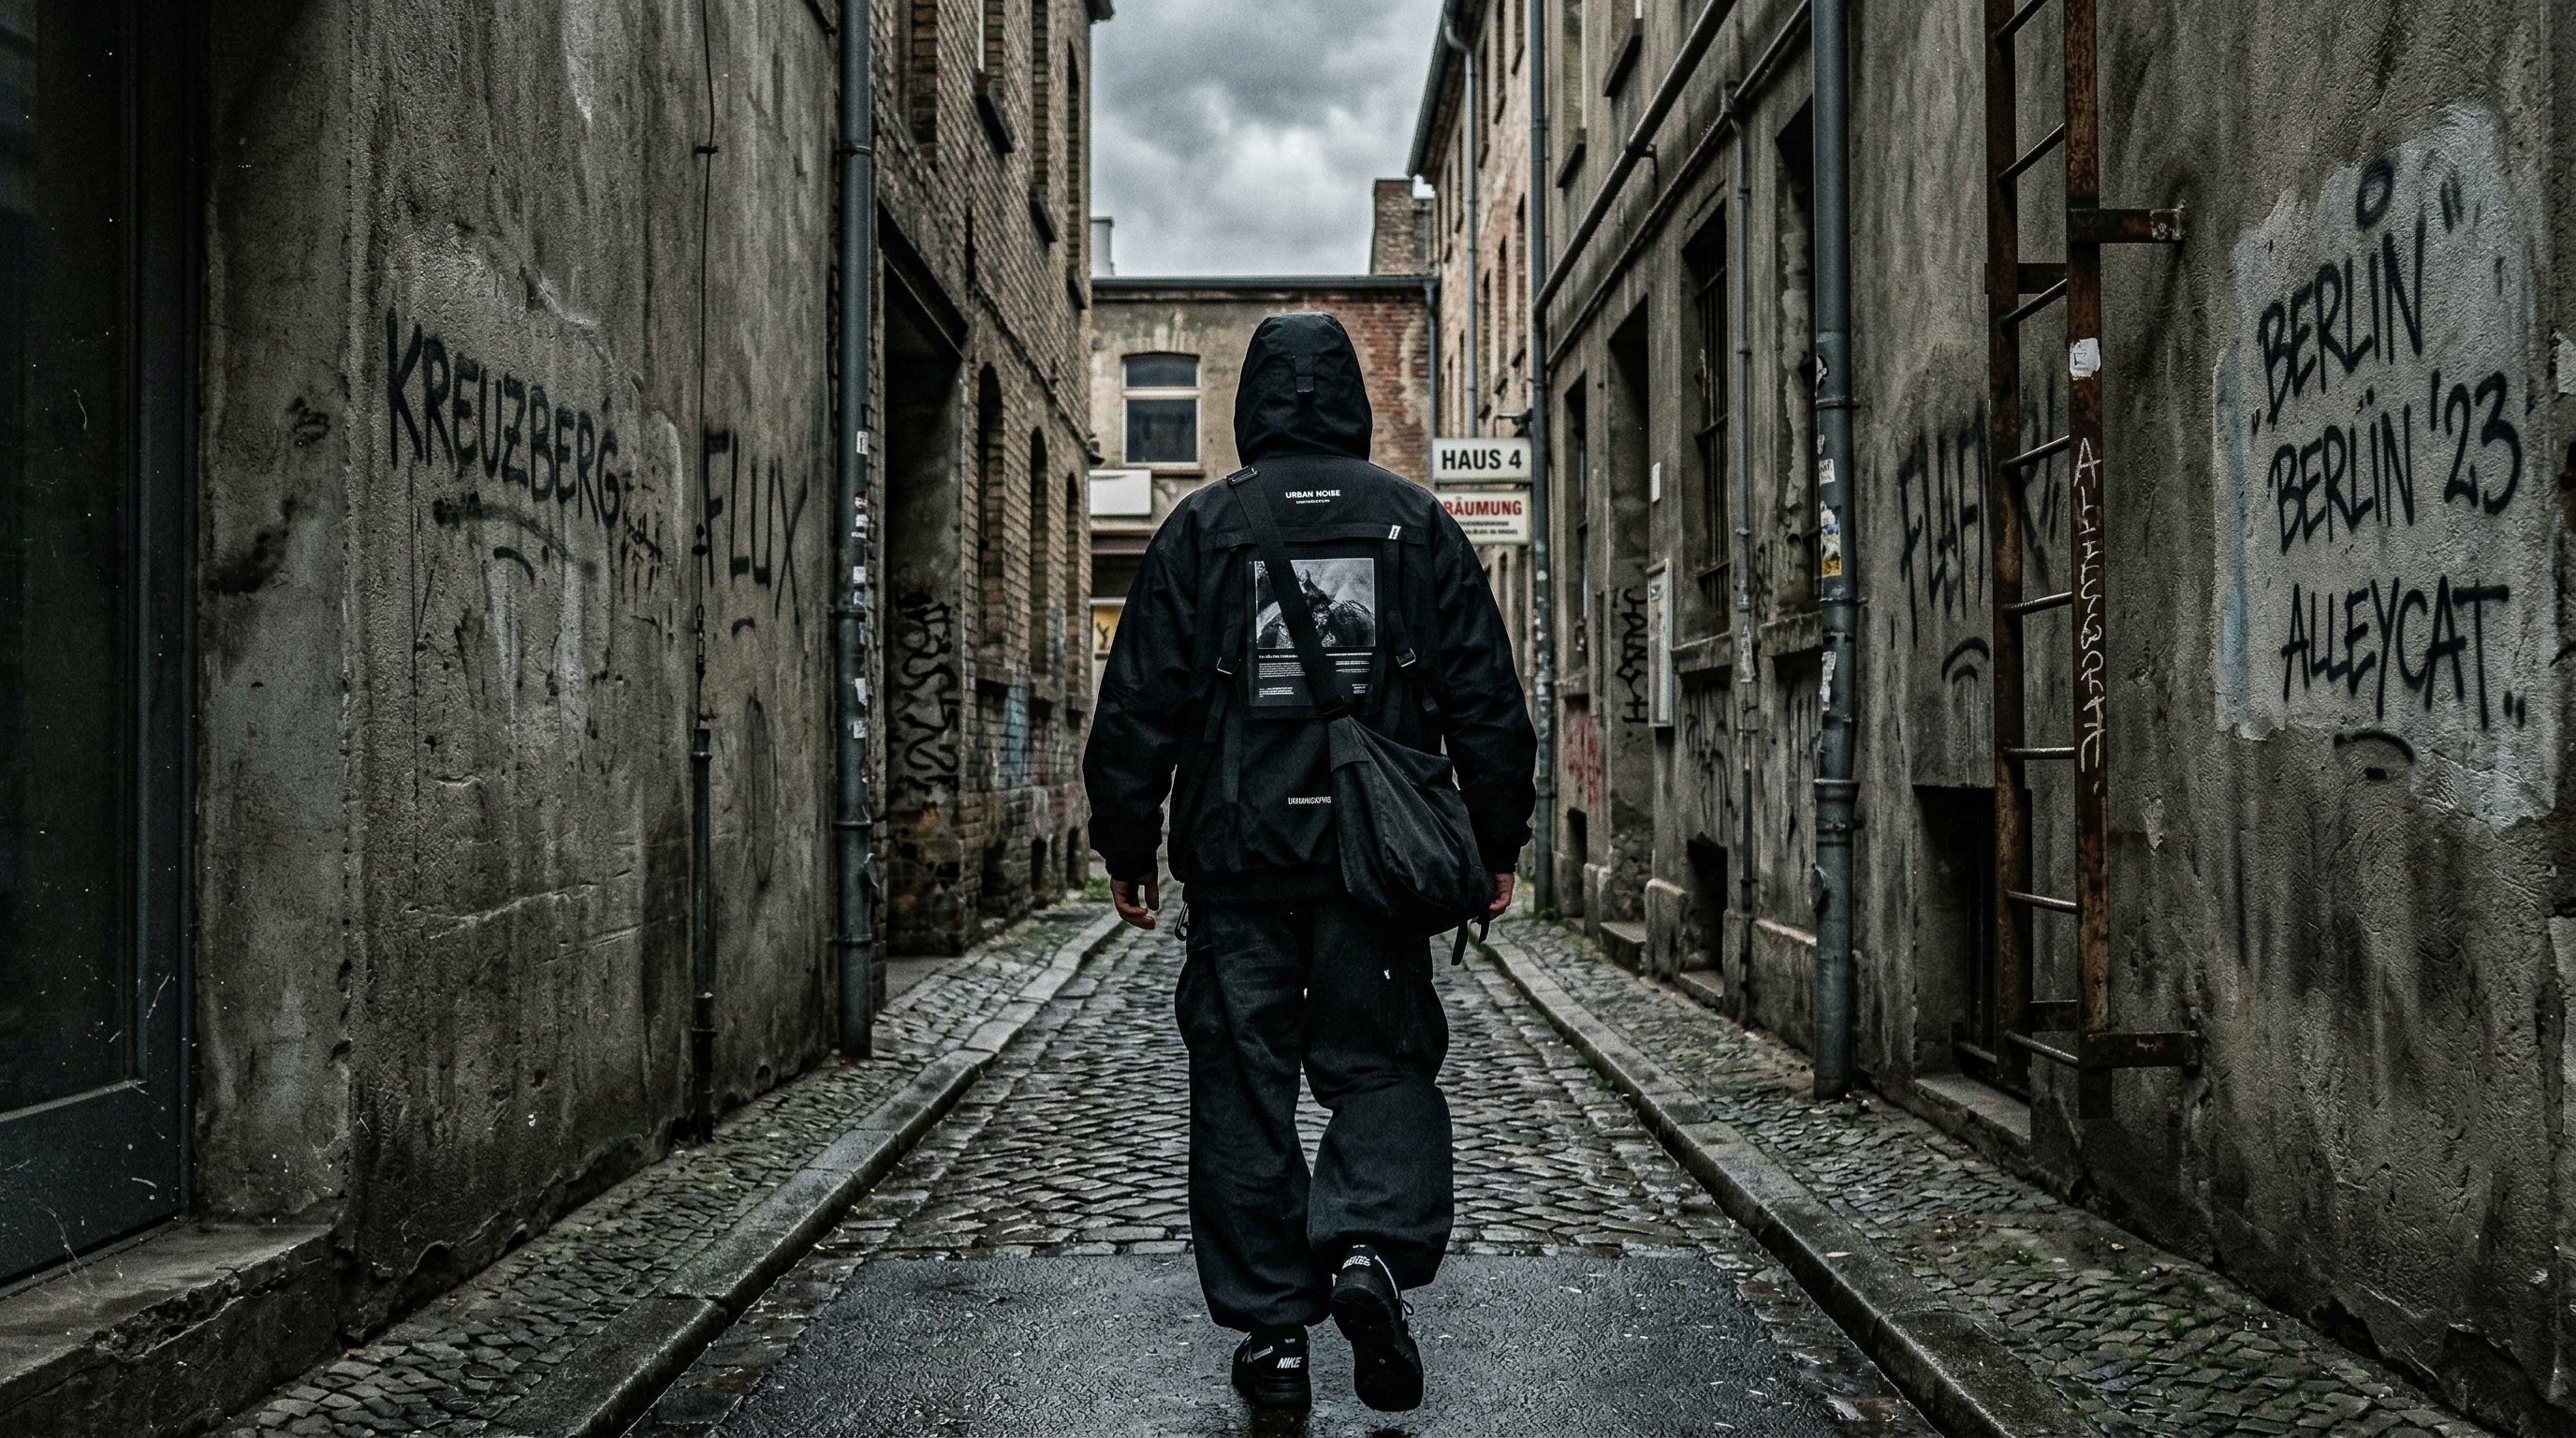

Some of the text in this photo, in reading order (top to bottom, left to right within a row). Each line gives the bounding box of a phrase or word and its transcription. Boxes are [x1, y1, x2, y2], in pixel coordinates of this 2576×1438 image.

[386, 306, 620, 528] KREUZBERG
[1442, 448, 1522, 470] HAUS 4
[2431, 371, 2522, 516] '23
[704, 423, 809, 625] FLUX
[1276, 1356, 1303, 1369] NIKE
